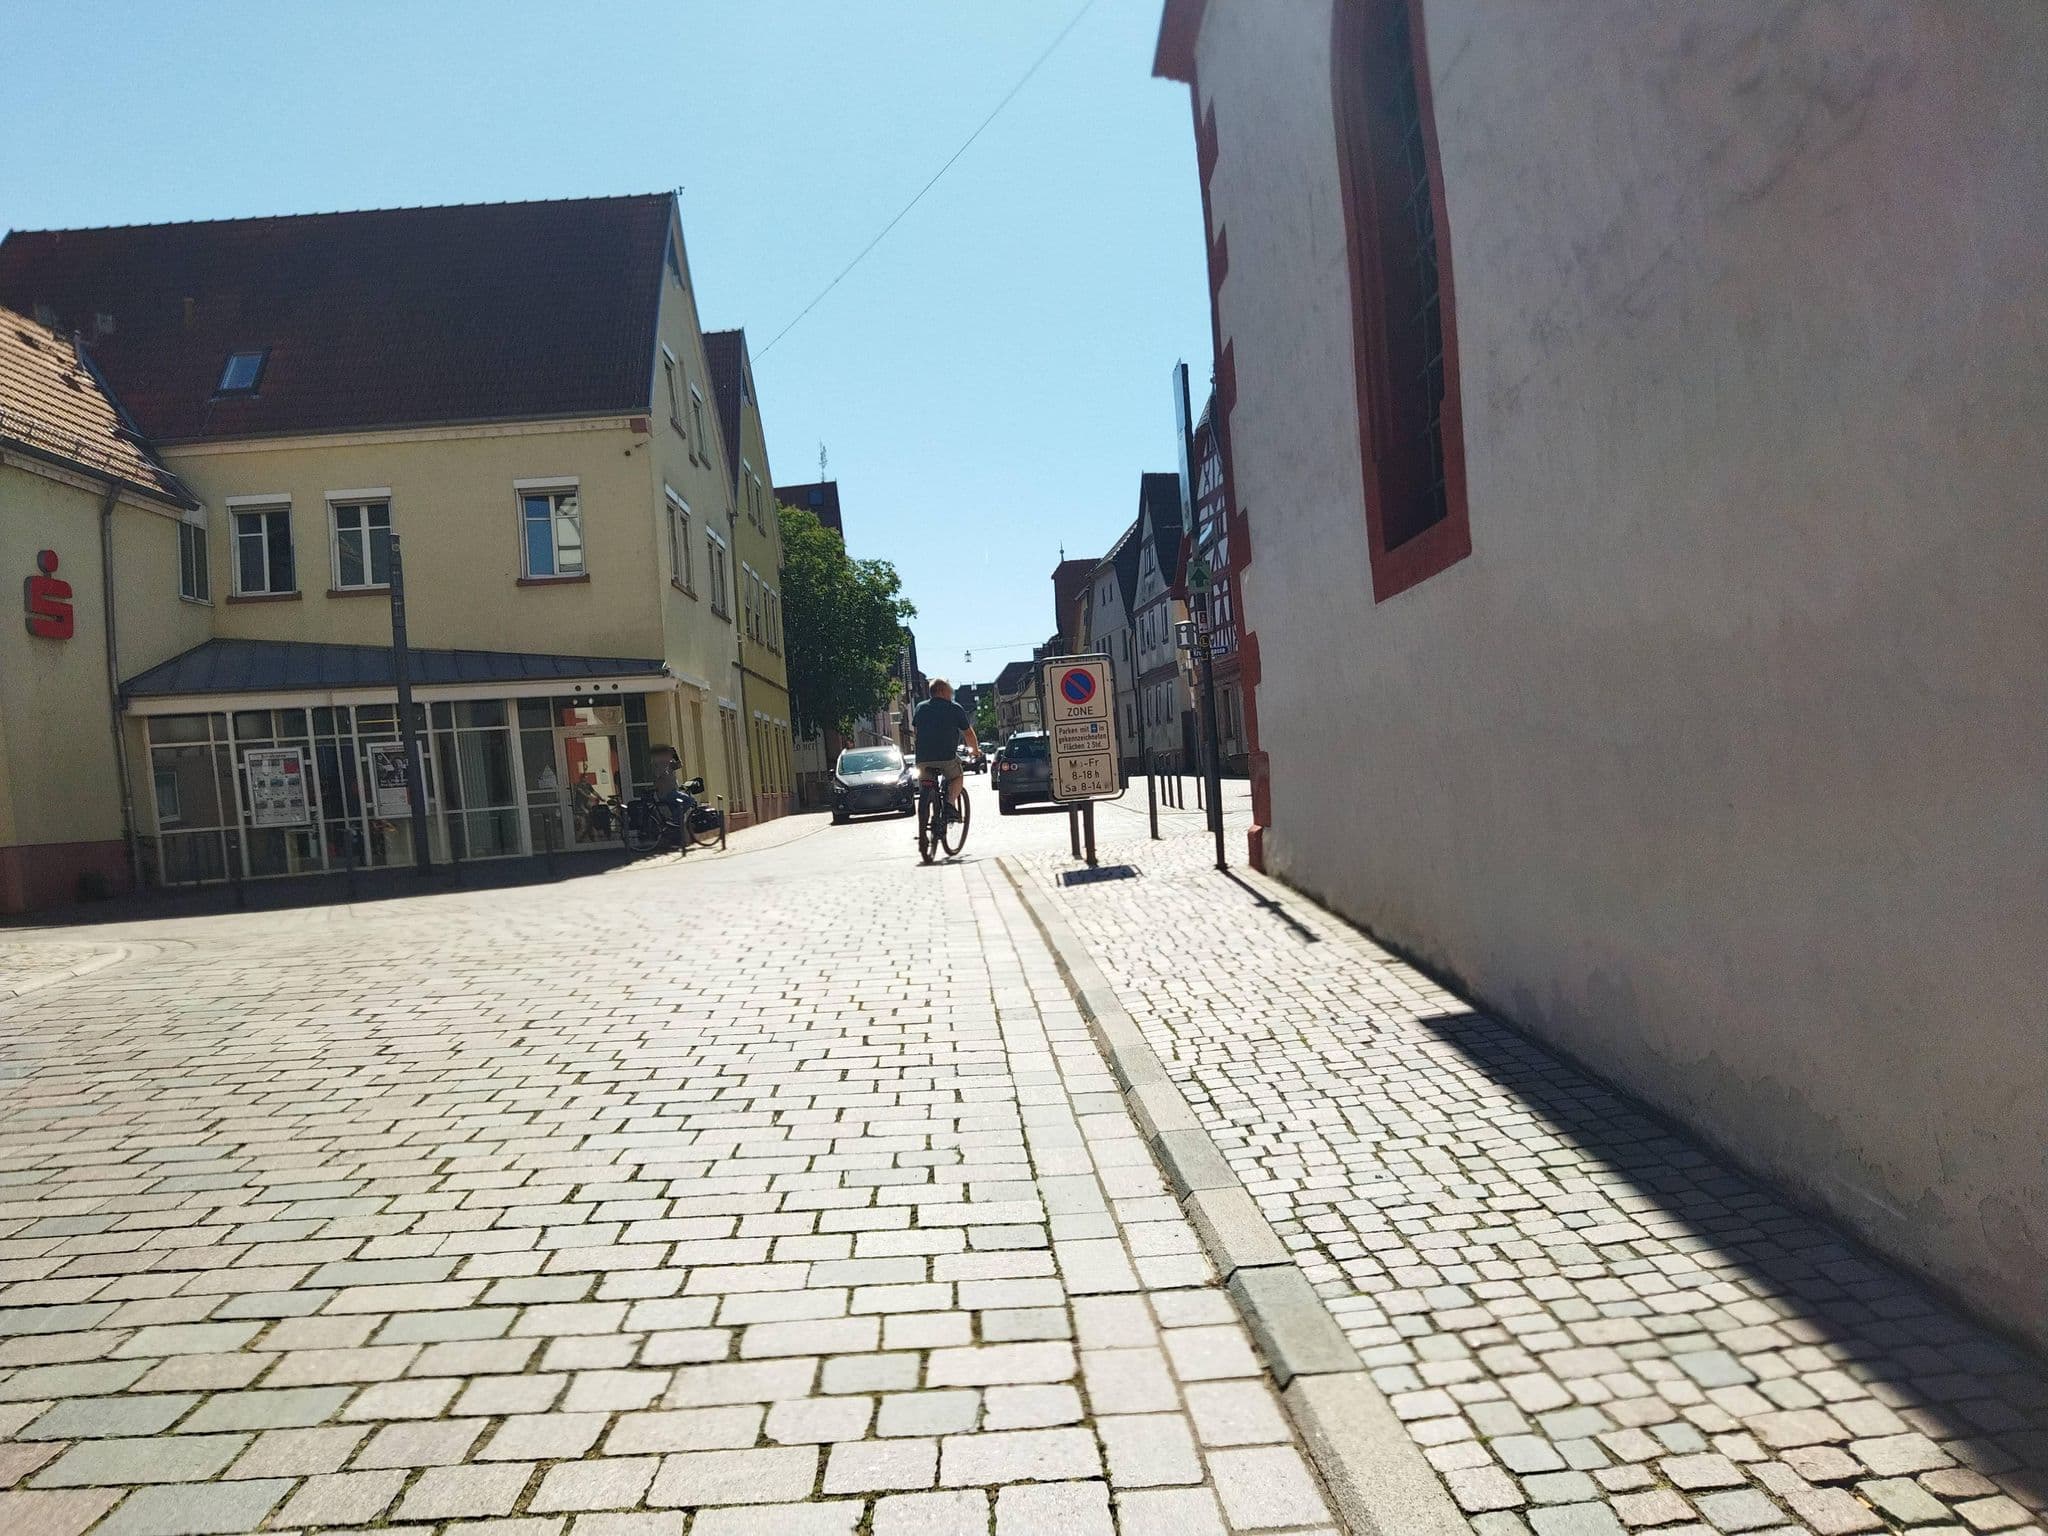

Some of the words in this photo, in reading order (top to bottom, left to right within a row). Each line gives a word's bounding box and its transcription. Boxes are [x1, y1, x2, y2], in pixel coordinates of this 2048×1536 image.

[1067, 706, 1094, 717] ZONE
[1058, 727, 1078, 736] Parken
[1080, 725, 1090, 733] mit
[1058, 733, 1107, 745] gekennzeichneten
[1063, 742, 1085, 751] Flächen
[1087, 741, 1091, 749] 2
[1072, 770, 1093, 780] 8-18
[1095, 769, 1100, 779] h
[1081, 781, 1102, 791] 8-14
